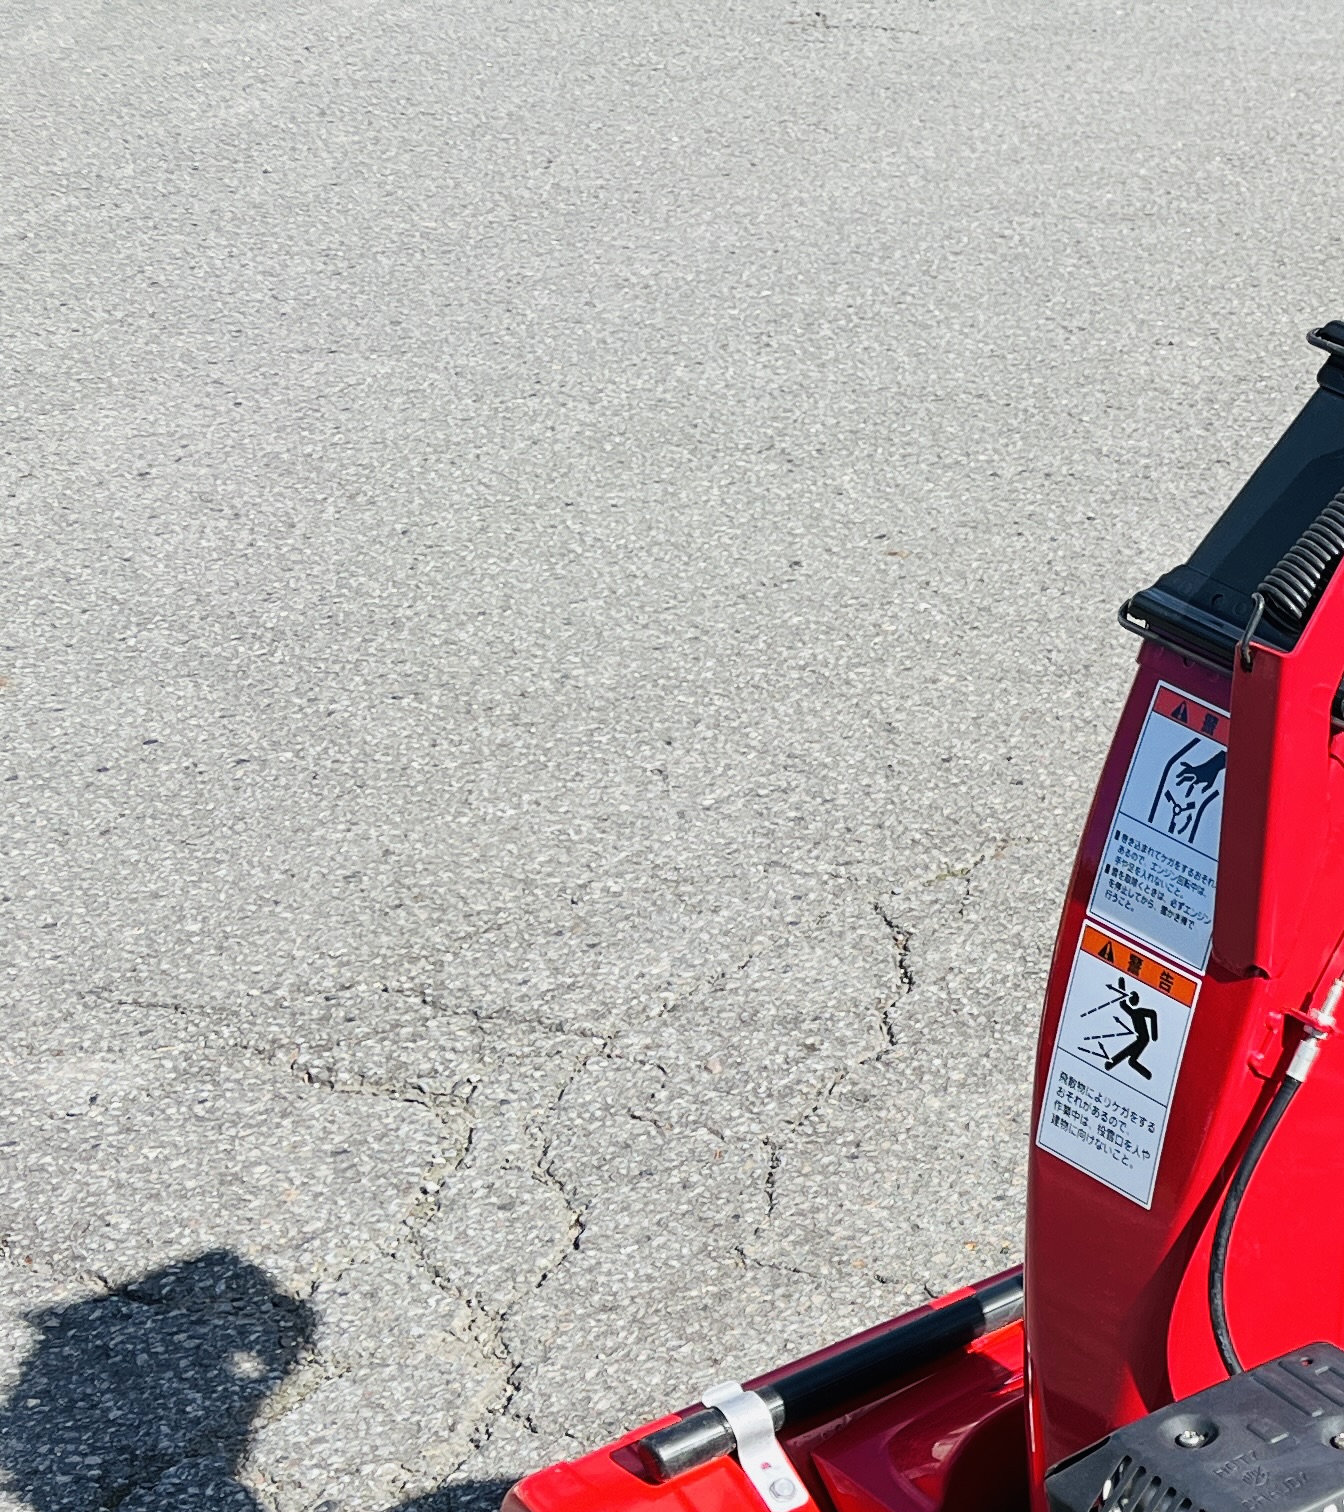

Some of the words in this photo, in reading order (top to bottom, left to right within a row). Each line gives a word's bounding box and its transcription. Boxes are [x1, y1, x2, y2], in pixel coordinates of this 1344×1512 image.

[1127, 958, 1174, 994] 警告
[1056, 1087, 1130, 1136] おそれがあるので、
[1059, 1070, 1156, 1133] 飛散物によりケガをする
[1050, 1112, 1134, 1169] 建物に向けないこと。
